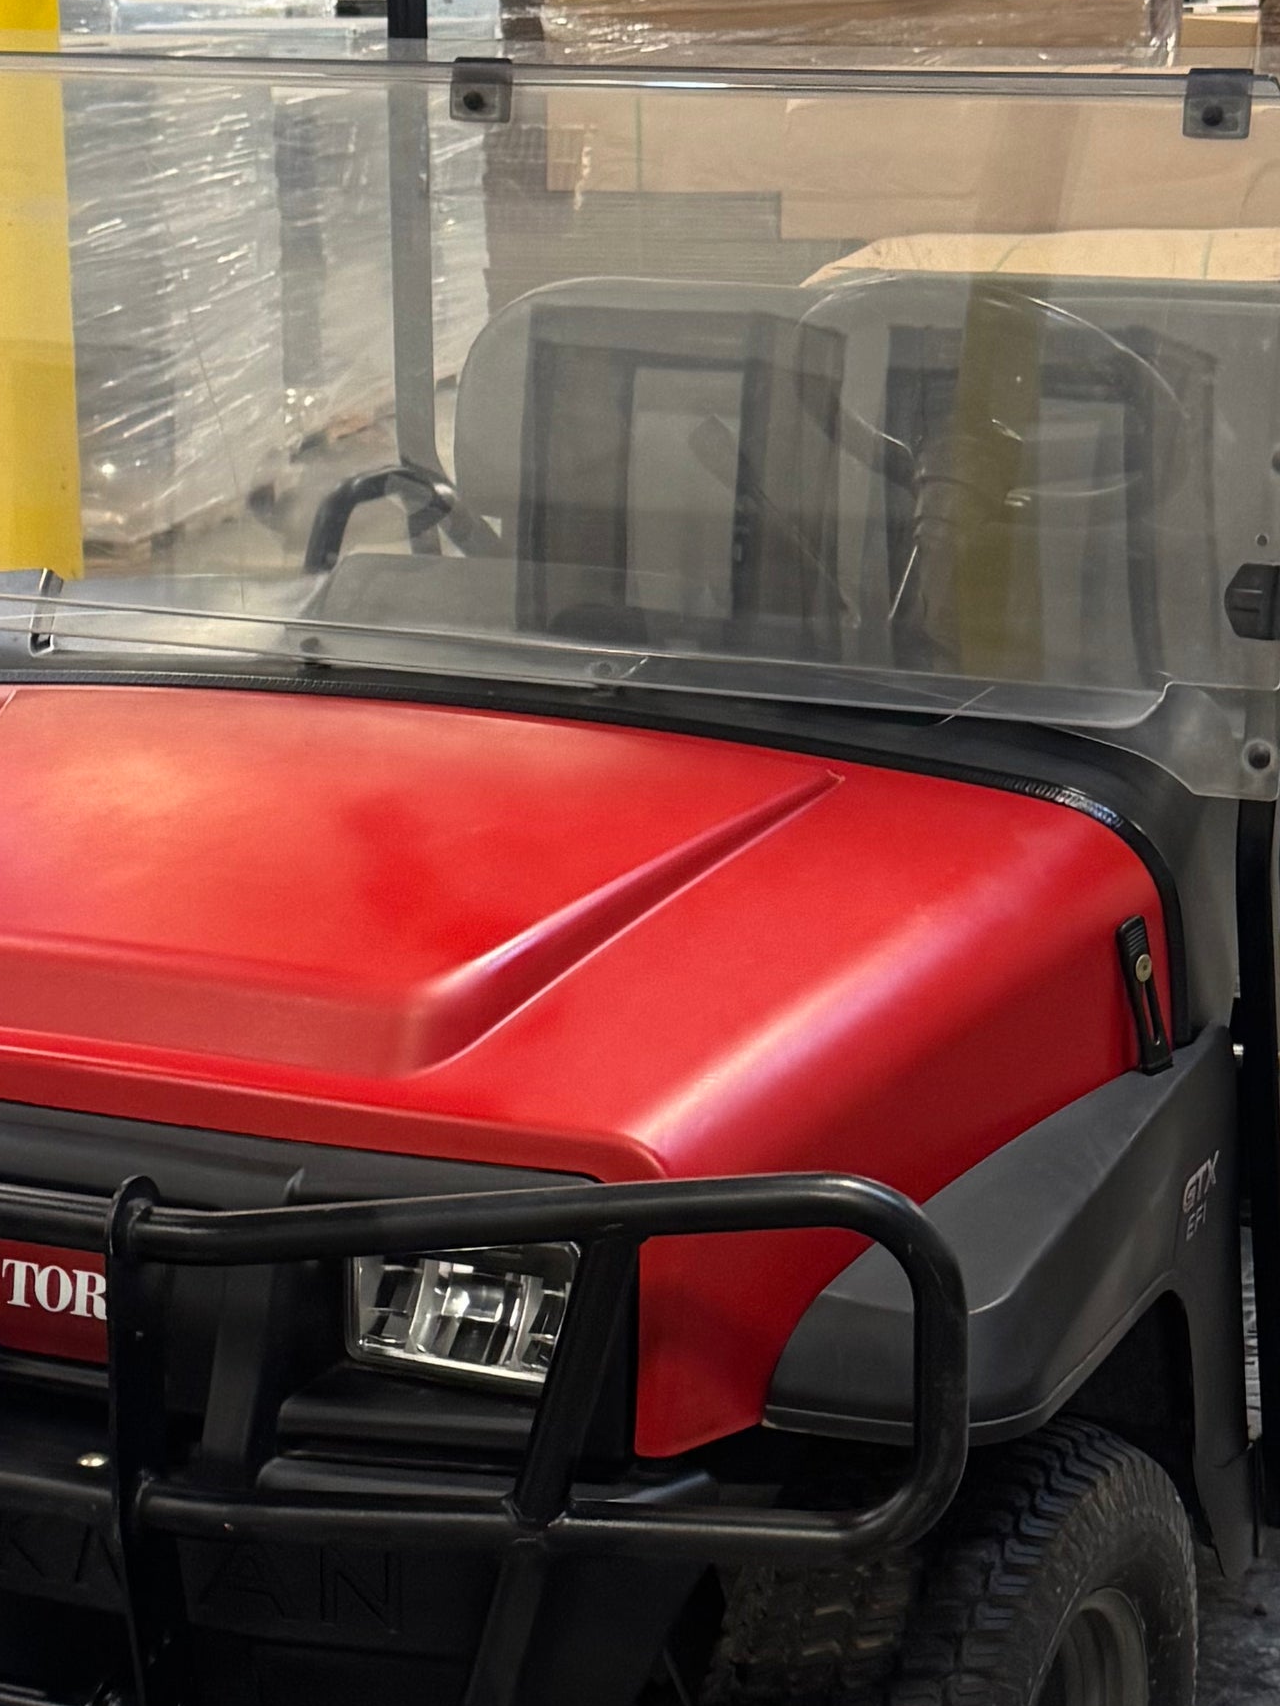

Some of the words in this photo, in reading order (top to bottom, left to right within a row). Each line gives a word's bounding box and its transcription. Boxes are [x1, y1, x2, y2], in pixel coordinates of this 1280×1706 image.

[1183, 1150, 1219, 1214] GTX
[1186, 1199, 1207, 1242] EFI
[2, 1259, 107, 1320] TOR
